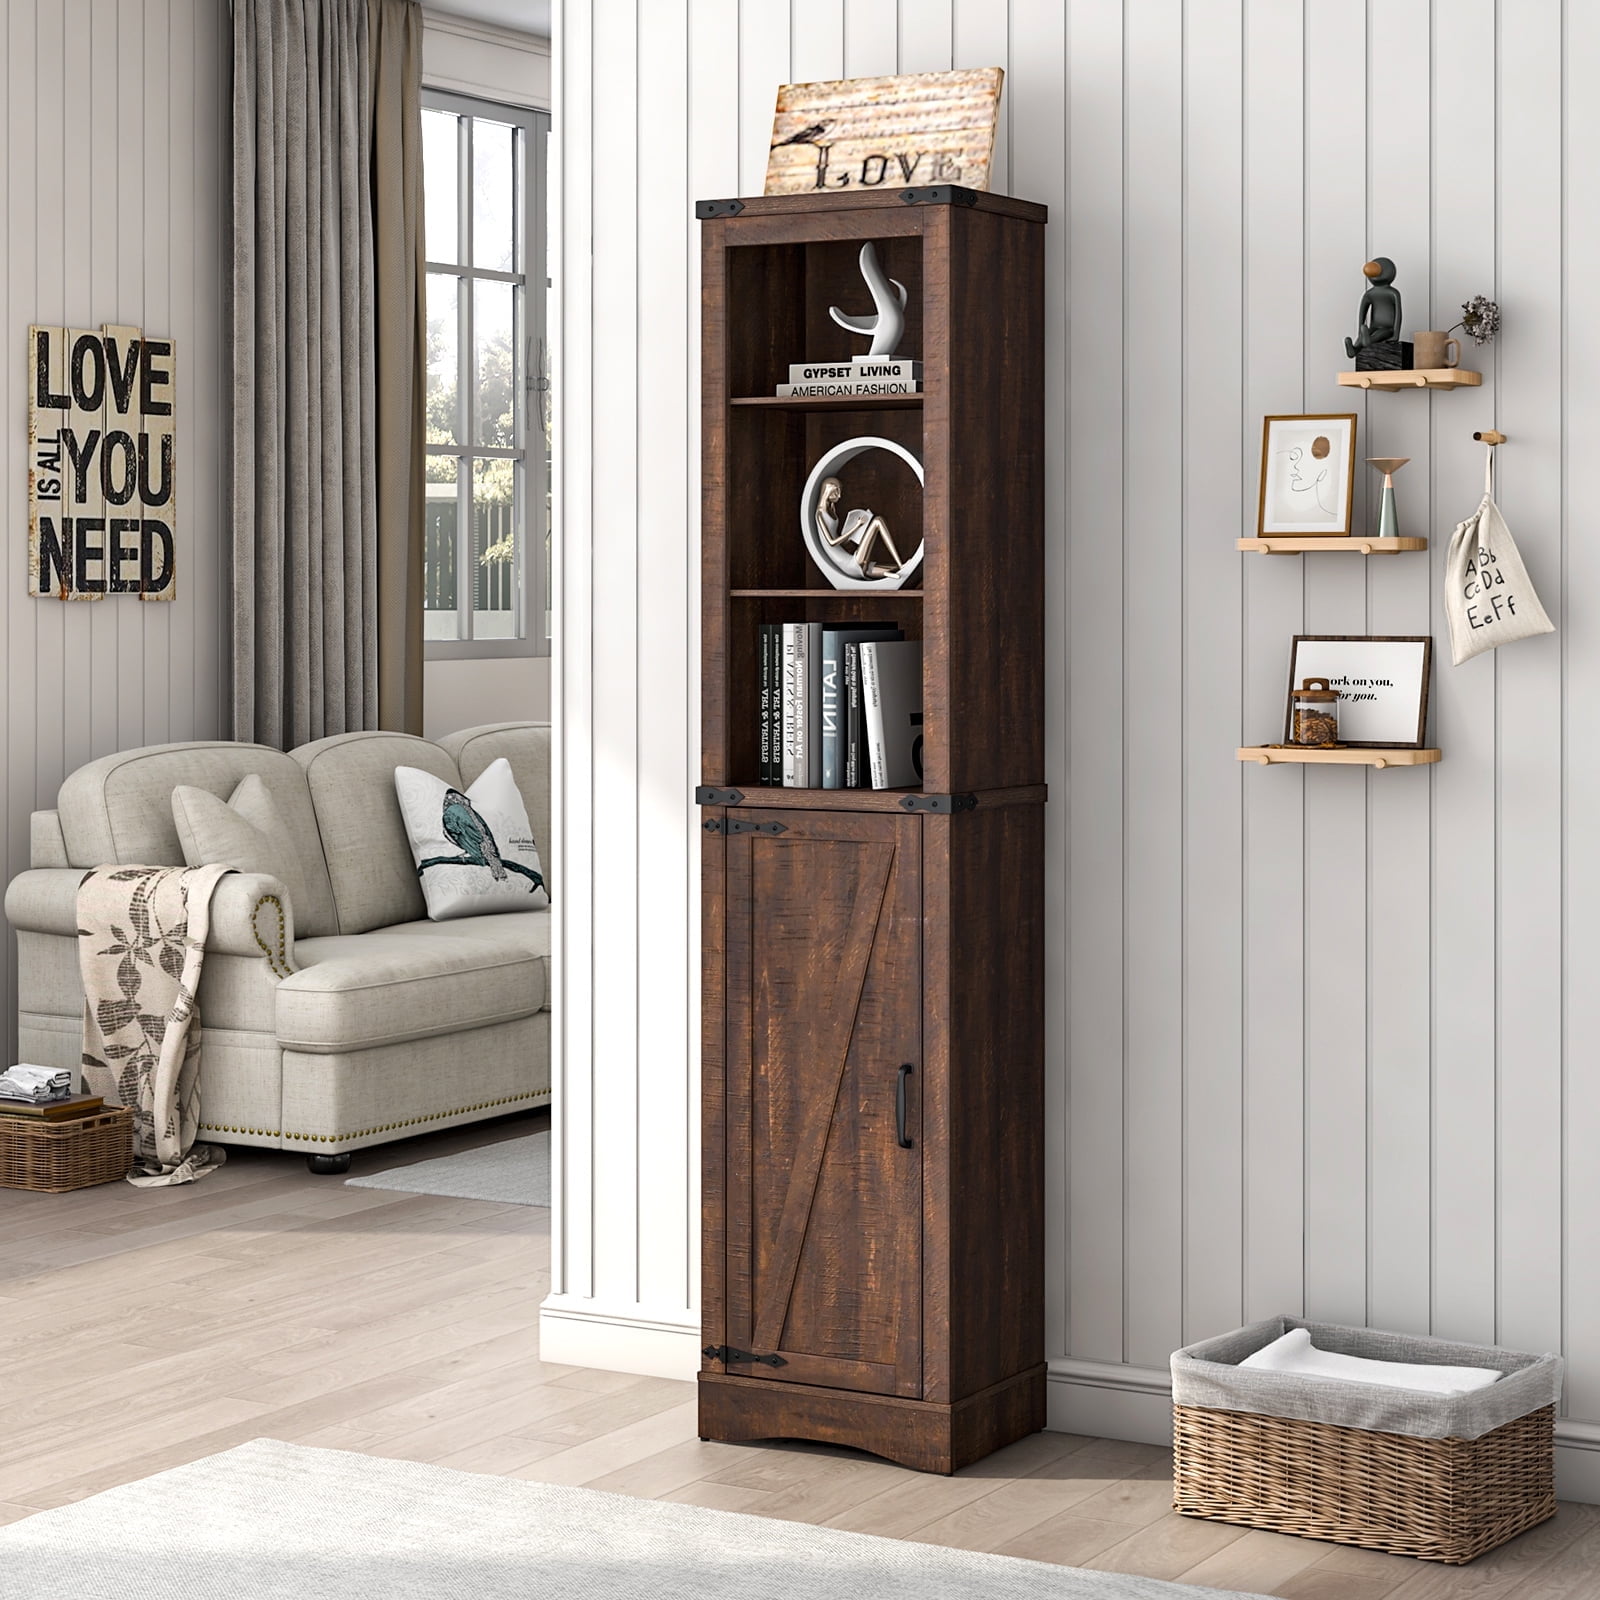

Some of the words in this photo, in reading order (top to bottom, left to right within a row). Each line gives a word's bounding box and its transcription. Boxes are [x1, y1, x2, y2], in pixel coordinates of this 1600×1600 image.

[813, 142, 963, 190] LOVE
[37, 330, 172, 416] LOVE
[803, 367, 852, 379] GYPSET
[860, 365, 901, 377] LIVING
[791, 385, 852, 397] AMERICAN
[856, 383, 907, 395] FASHION
[37, 429, 61, 473] ALL
[61, 428, 172, 507] YOU
[37, 478, 61, 500] IS
[39, 517, 174, 593] NEED
[1330, 675, 1350, 686] ork
[1368, 679, 1394, 689] you.
[1339, 690, 1351, 700] or
[1351, 693, 1378, 702] you.
